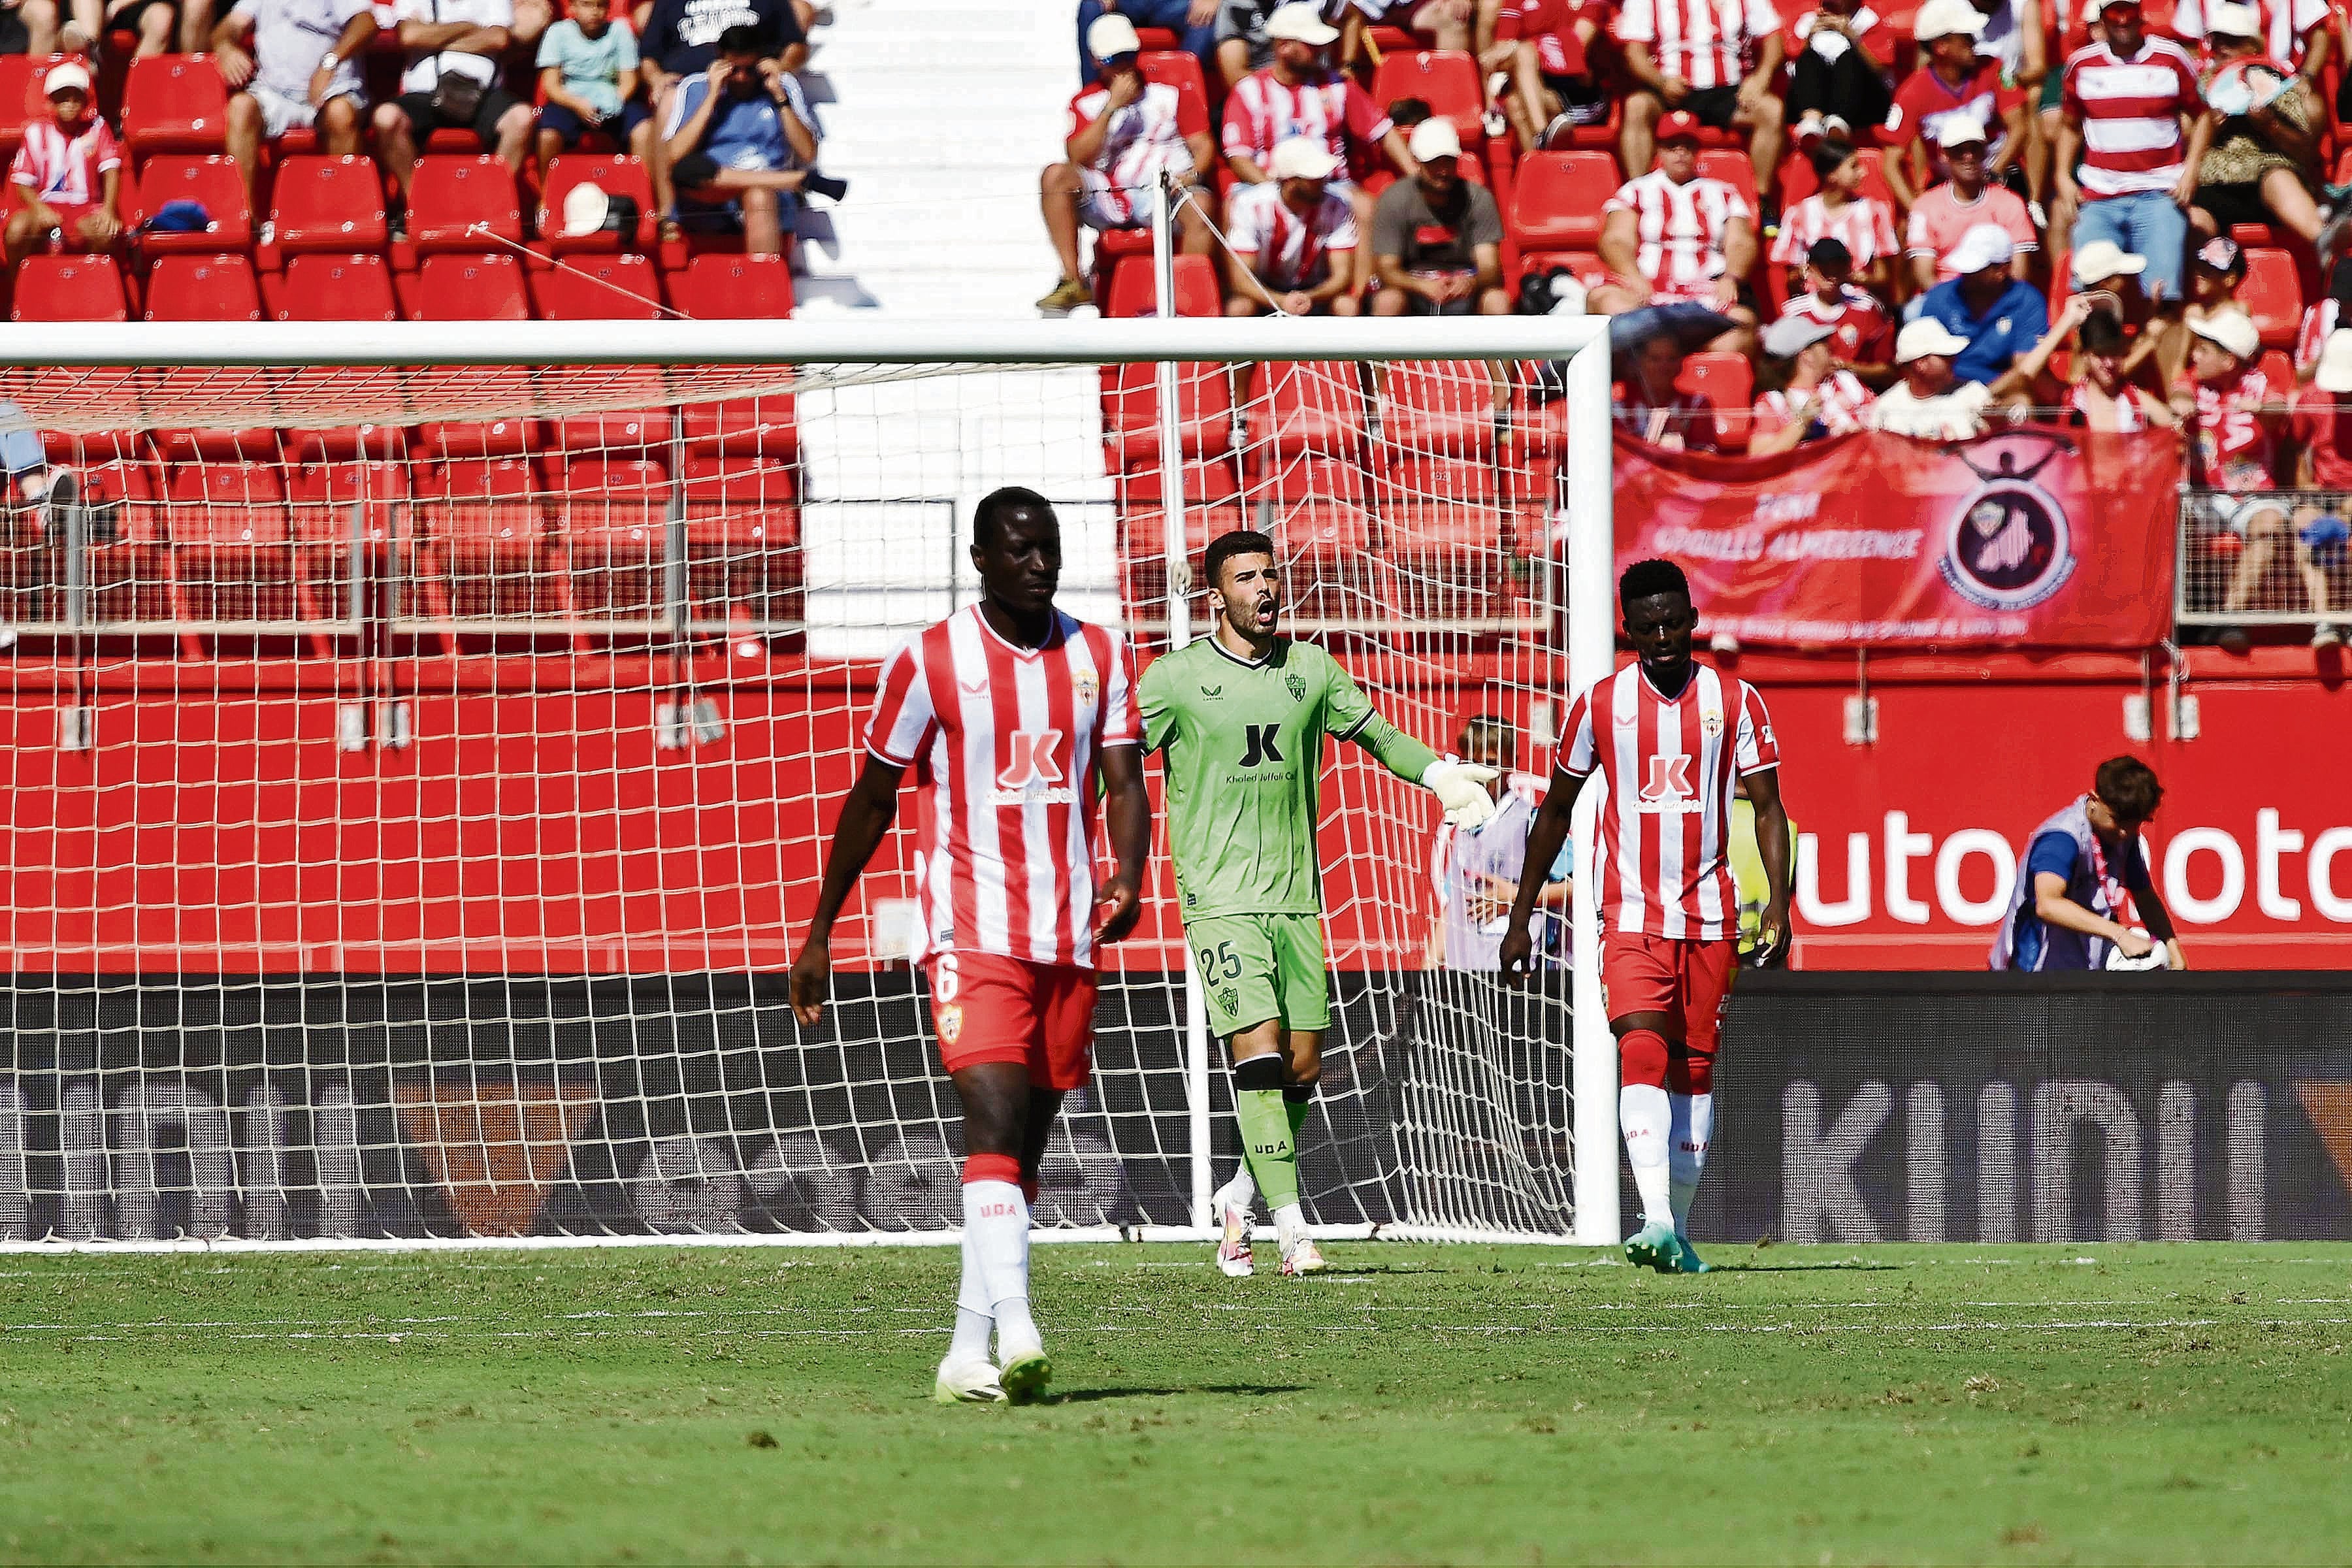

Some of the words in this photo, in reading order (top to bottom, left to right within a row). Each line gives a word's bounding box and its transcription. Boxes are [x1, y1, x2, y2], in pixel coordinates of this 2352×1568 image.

[998, 729, 1063, 788] JK
[1238, 723, 1285, 766] JK
[1640, 754, 1693, 800] JK
[936, 953, 958, 1004] 6
[1201, 940, 1241, 987] 25
[1255, 1141, 1287, 1154] UDA
[981, 1203, 1017, 1218] UDA
